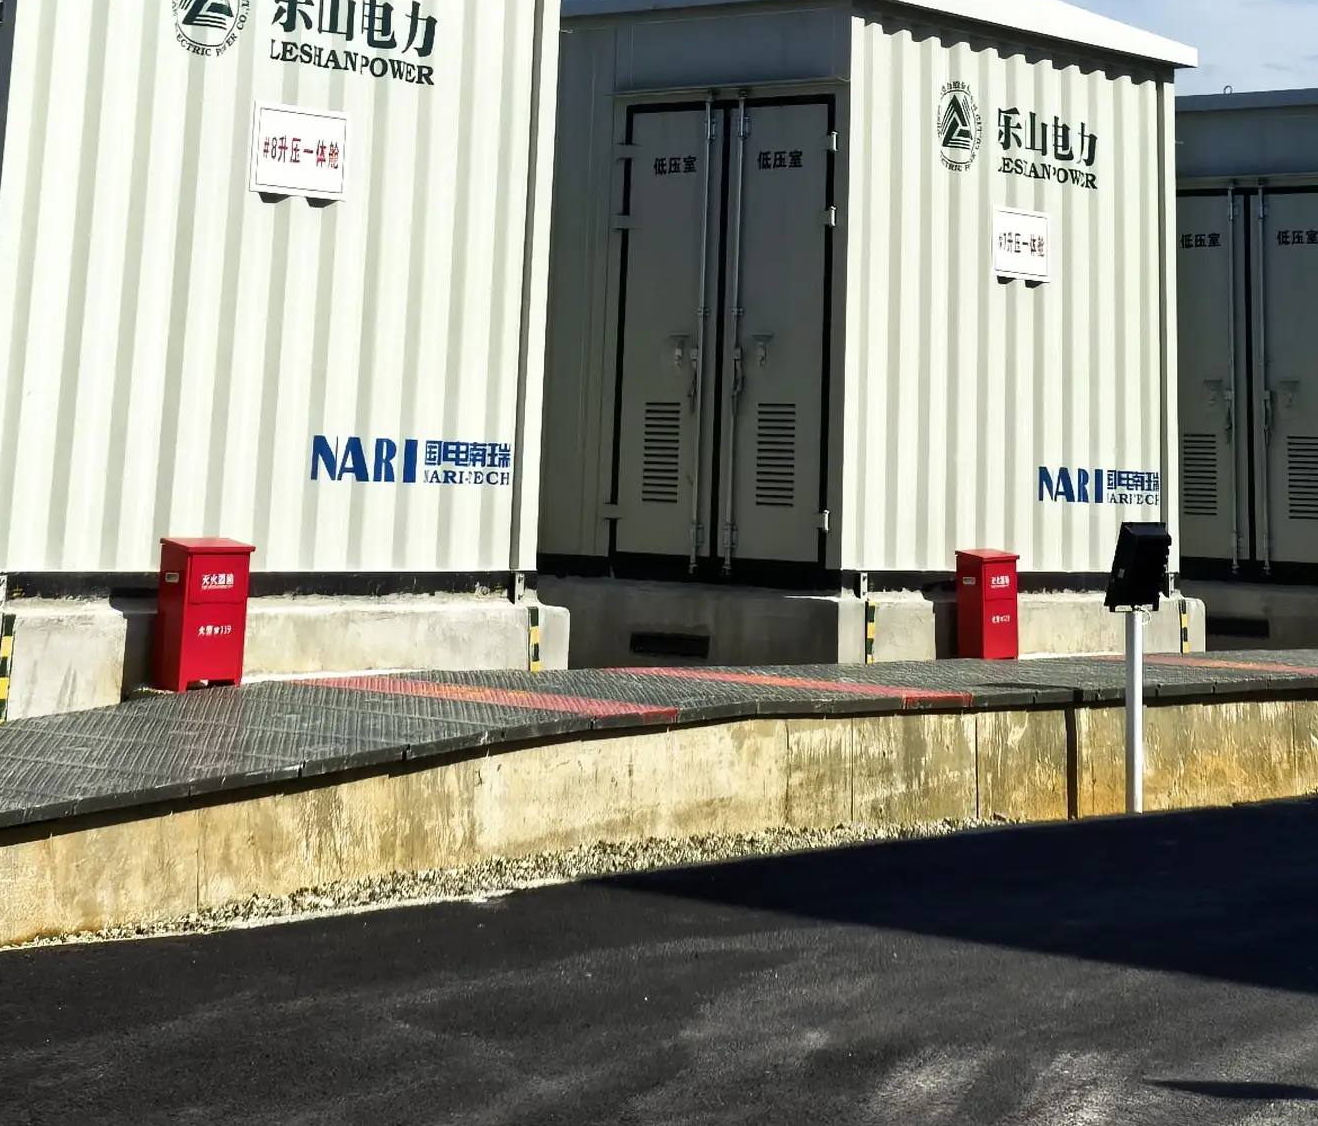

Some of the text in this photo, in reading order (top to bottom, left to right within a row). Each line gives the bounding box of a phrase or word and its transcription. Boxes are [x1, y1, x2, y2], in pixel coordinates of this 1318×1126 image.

[997, 107, 1098, 167] 乐山电力
[653, 155, 697, 176] 低压室
[757, 150, 803, 171] 低压室
[311, 435, 418, 483] NARI
[424, 440, 511, 469] 国电南瑞
[1038, 466, 1103, 503] NARI
